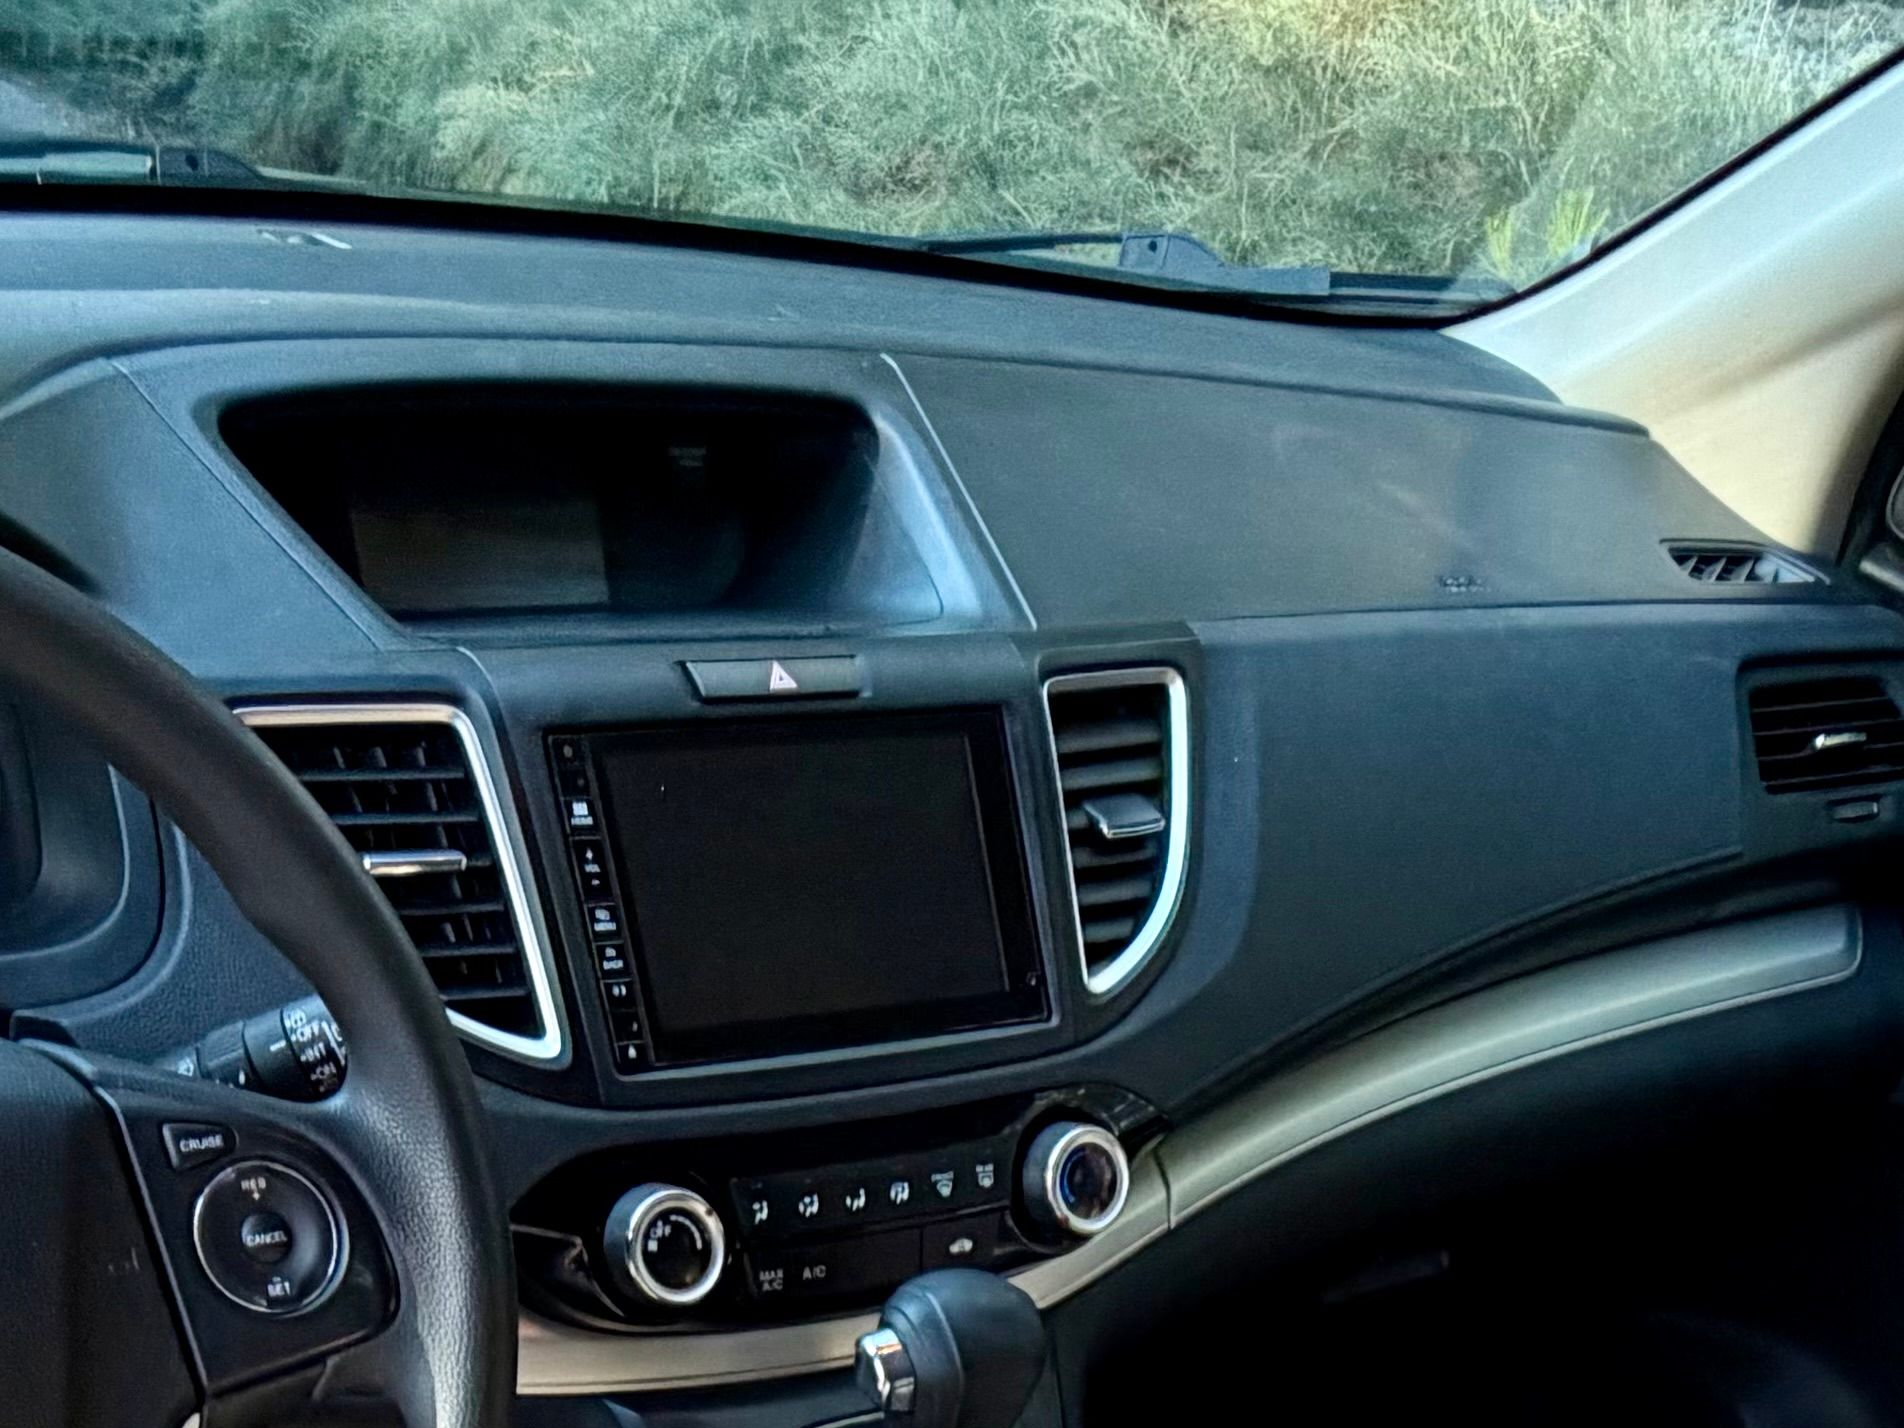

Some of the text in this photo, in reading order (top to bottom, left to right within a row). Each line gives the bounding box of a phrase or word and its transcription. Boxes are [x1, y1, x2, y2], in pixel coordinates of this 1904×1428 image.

[179, 1135, 225, 1152] CRUISE
[246, 1230, 288, 1248] CANCEL
[802, 1265, 827, 1280] A/C
